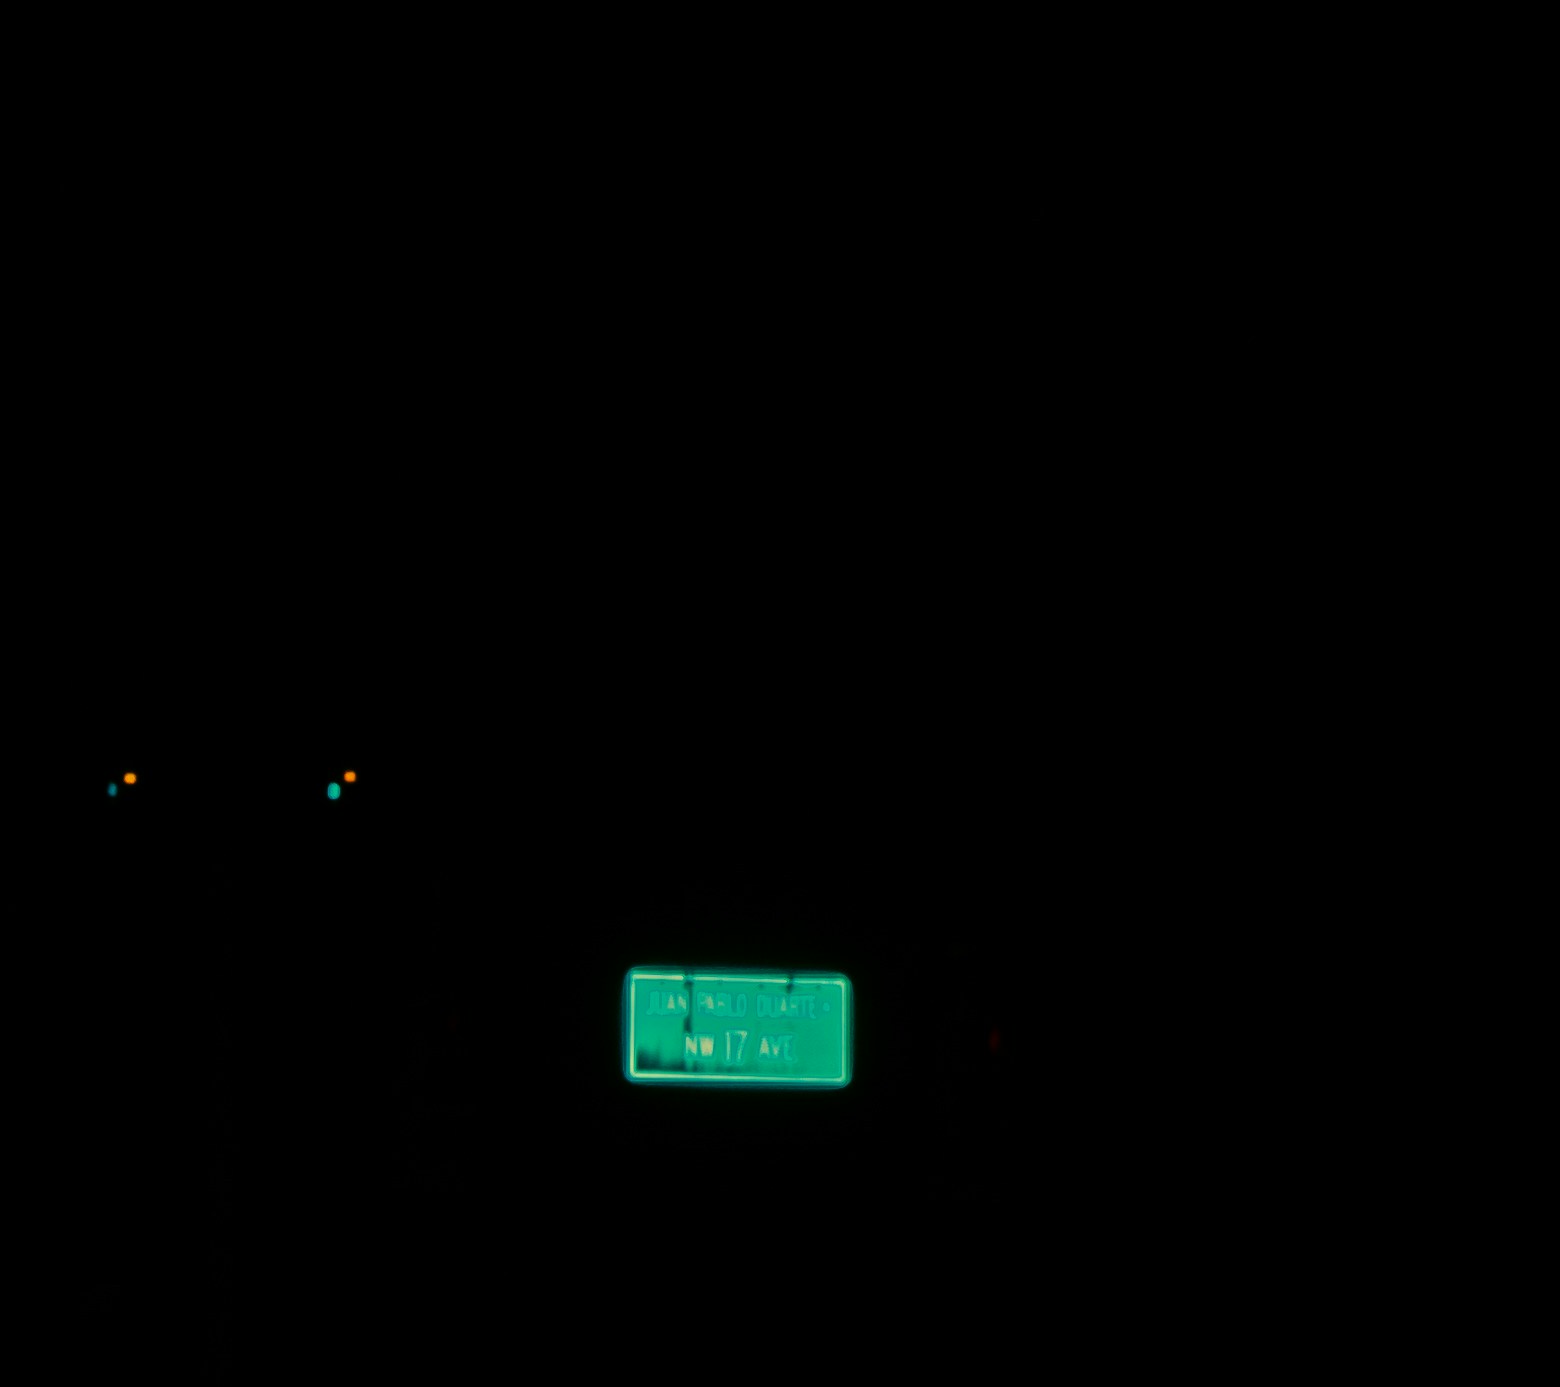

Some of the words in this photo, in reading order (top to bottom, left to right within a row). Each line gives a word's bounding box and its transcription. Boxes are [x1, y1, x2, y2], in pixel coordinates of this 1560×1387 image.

[646, 991, 688, 1016] JUAN
[697, 991, 747, 1018] PABLO
[684, 1033, 715, 1058] NW
[725, 1030, 749, 1063] 17
[758, 1034, 795, 1062] AVE
